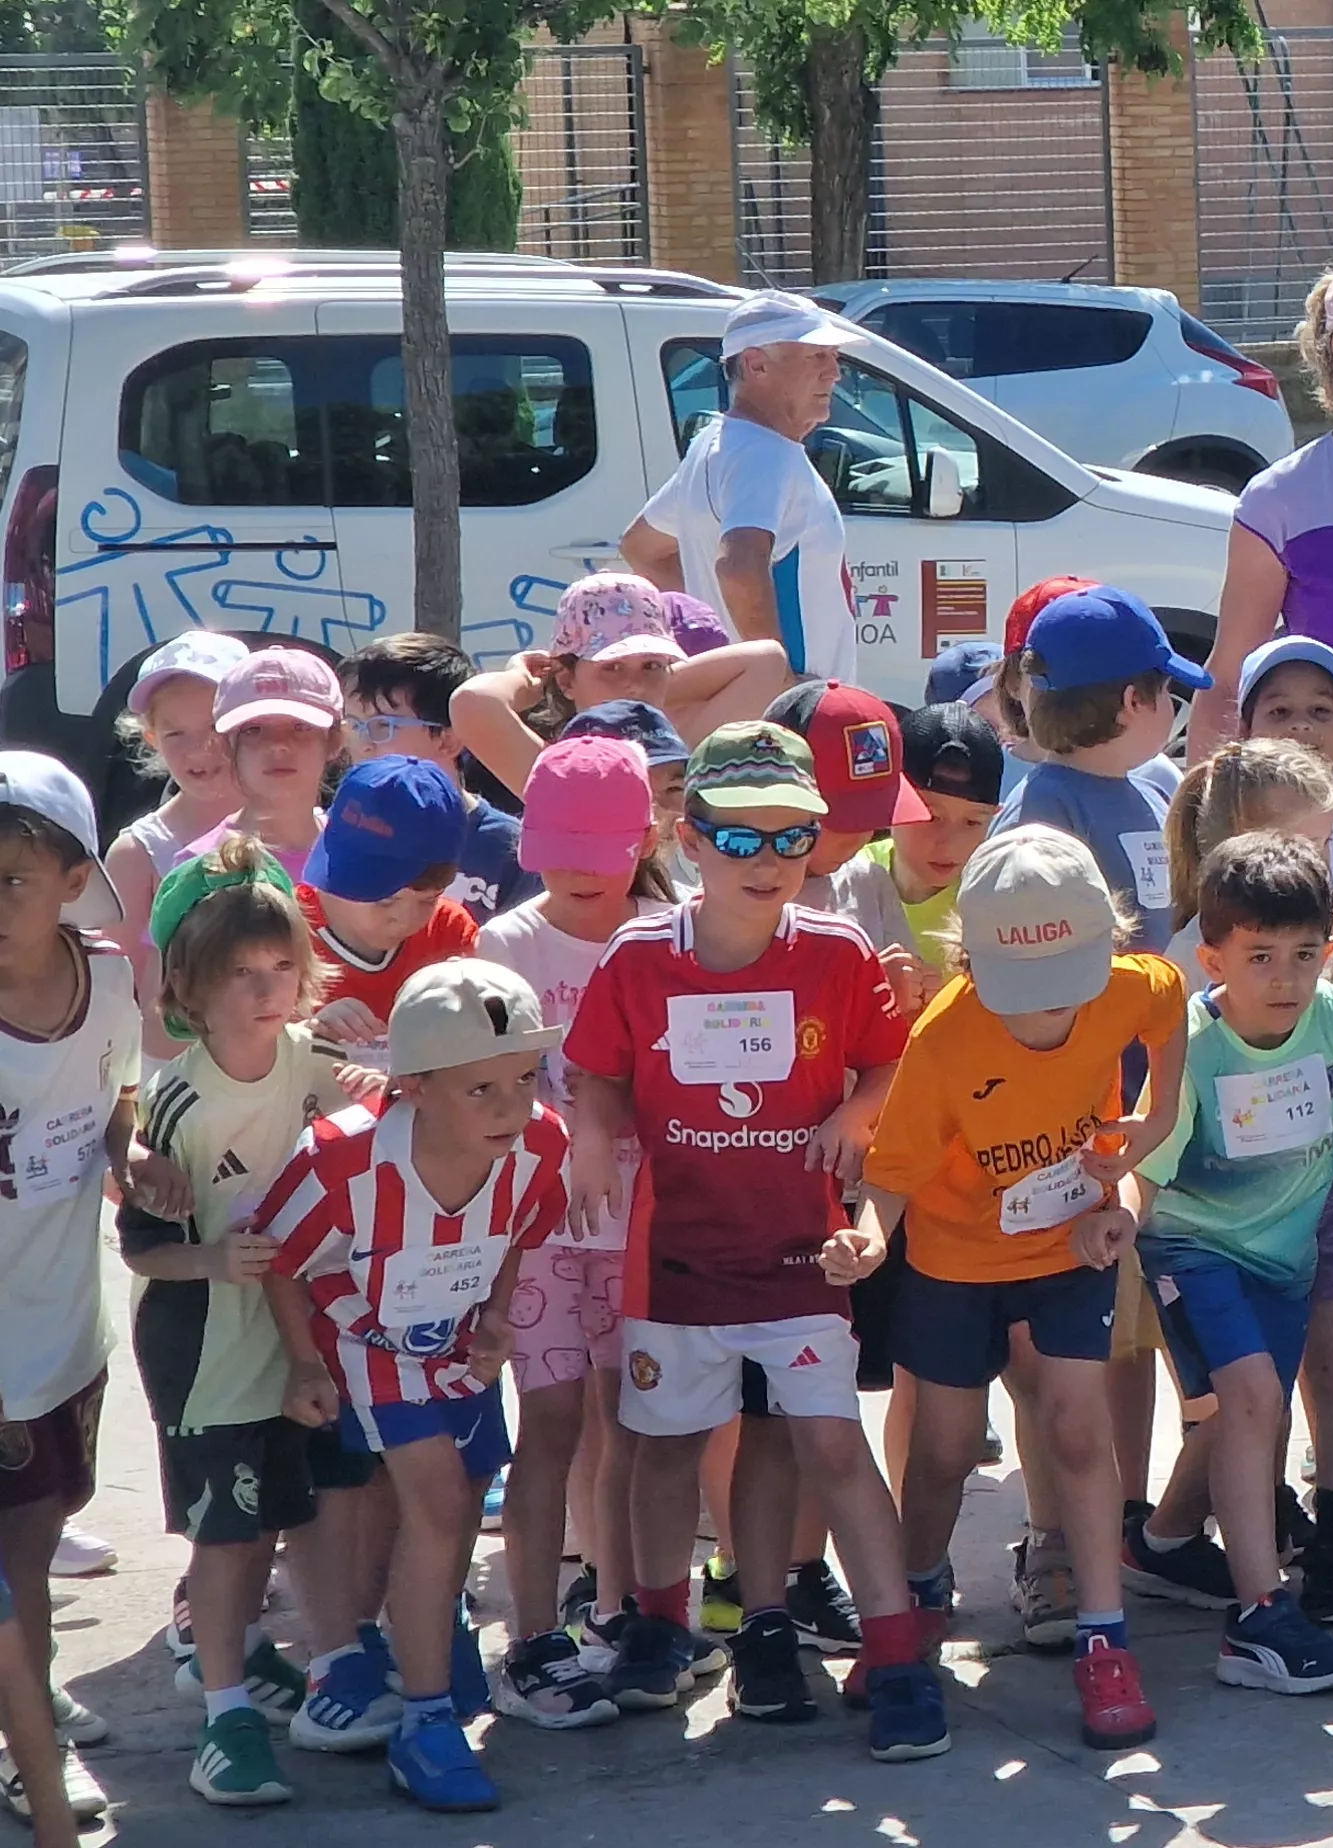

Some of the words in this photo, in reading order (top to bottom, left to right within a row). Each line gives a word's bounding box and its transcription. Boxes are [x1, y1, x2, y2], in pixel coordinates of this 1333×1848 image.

[996, 919, 1073, 945] LALIGA
[738, 1037, 773, 1053] 156
[1285, 1101, 1315, 1121] 112
[977, 1133, 1053, 1176] PEDRO
[449, 1275, 481, 1293] 452
